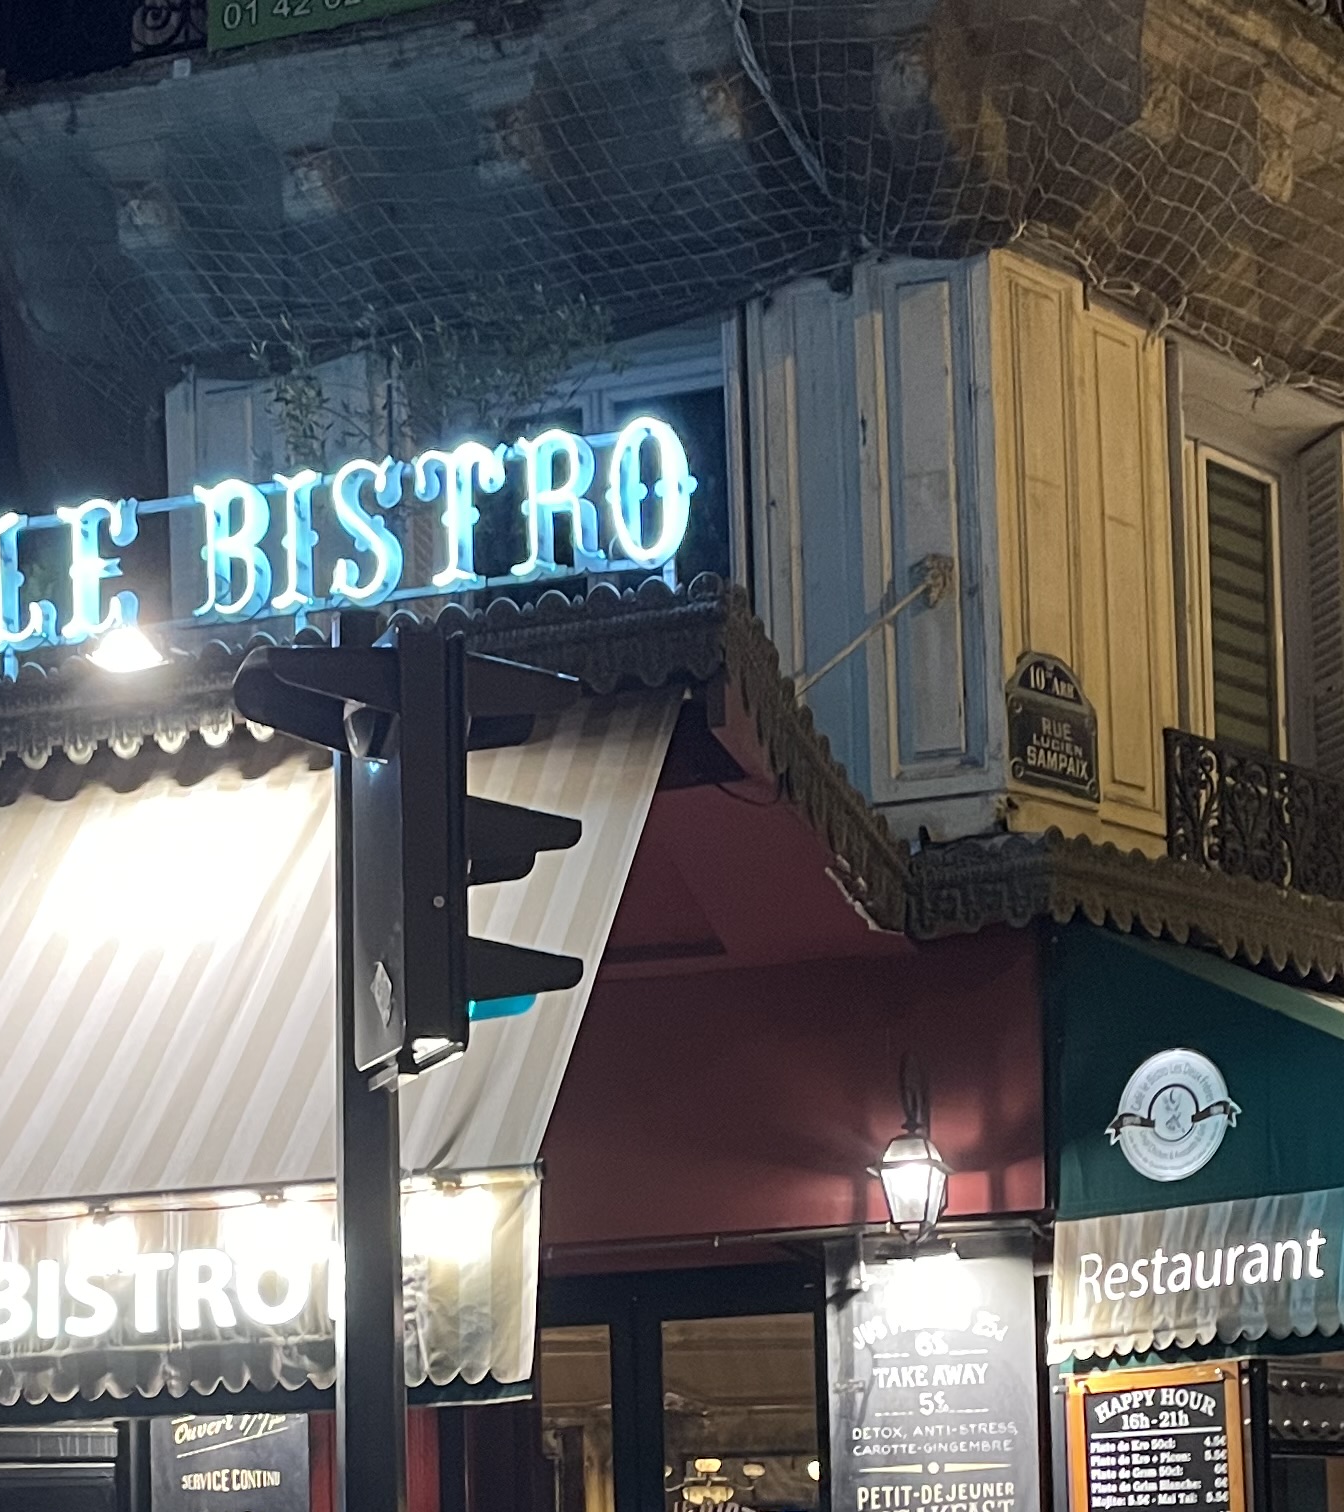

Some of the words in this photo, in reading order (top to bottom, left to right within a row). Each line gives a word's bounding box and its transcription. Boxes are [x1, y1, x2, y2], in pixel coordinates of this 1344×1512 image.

[223, 0, 258, 29] 01
[194, 416, 698, 619] BISTRO
[1042, 717, 1072, 742] RUE
[1033, 733, 1083, 758] LUCIEN
[1027, 746, 1088, 780] SAMPAIX
[1078, 1228, 1327, 1304] Restaurant
[872, 1365, 929, 1388] TAKE
[932, 1363, 989, 1387] AWAY
[1094, 1389, 1155, 1423] HAPPY
[1160, 1388, 1216, 1416] HOUR
[852, 1426, 908, 1441] DETOX,
[913, 1422, 1019, 1437] ANTI-STRESS,
[852, 1440, 1014, 1457] CAROTTE-GINGEMBRE
[182, 1468, 229, 1492] SERVICE
[233, 1469, 281, 1491] CONTINU
